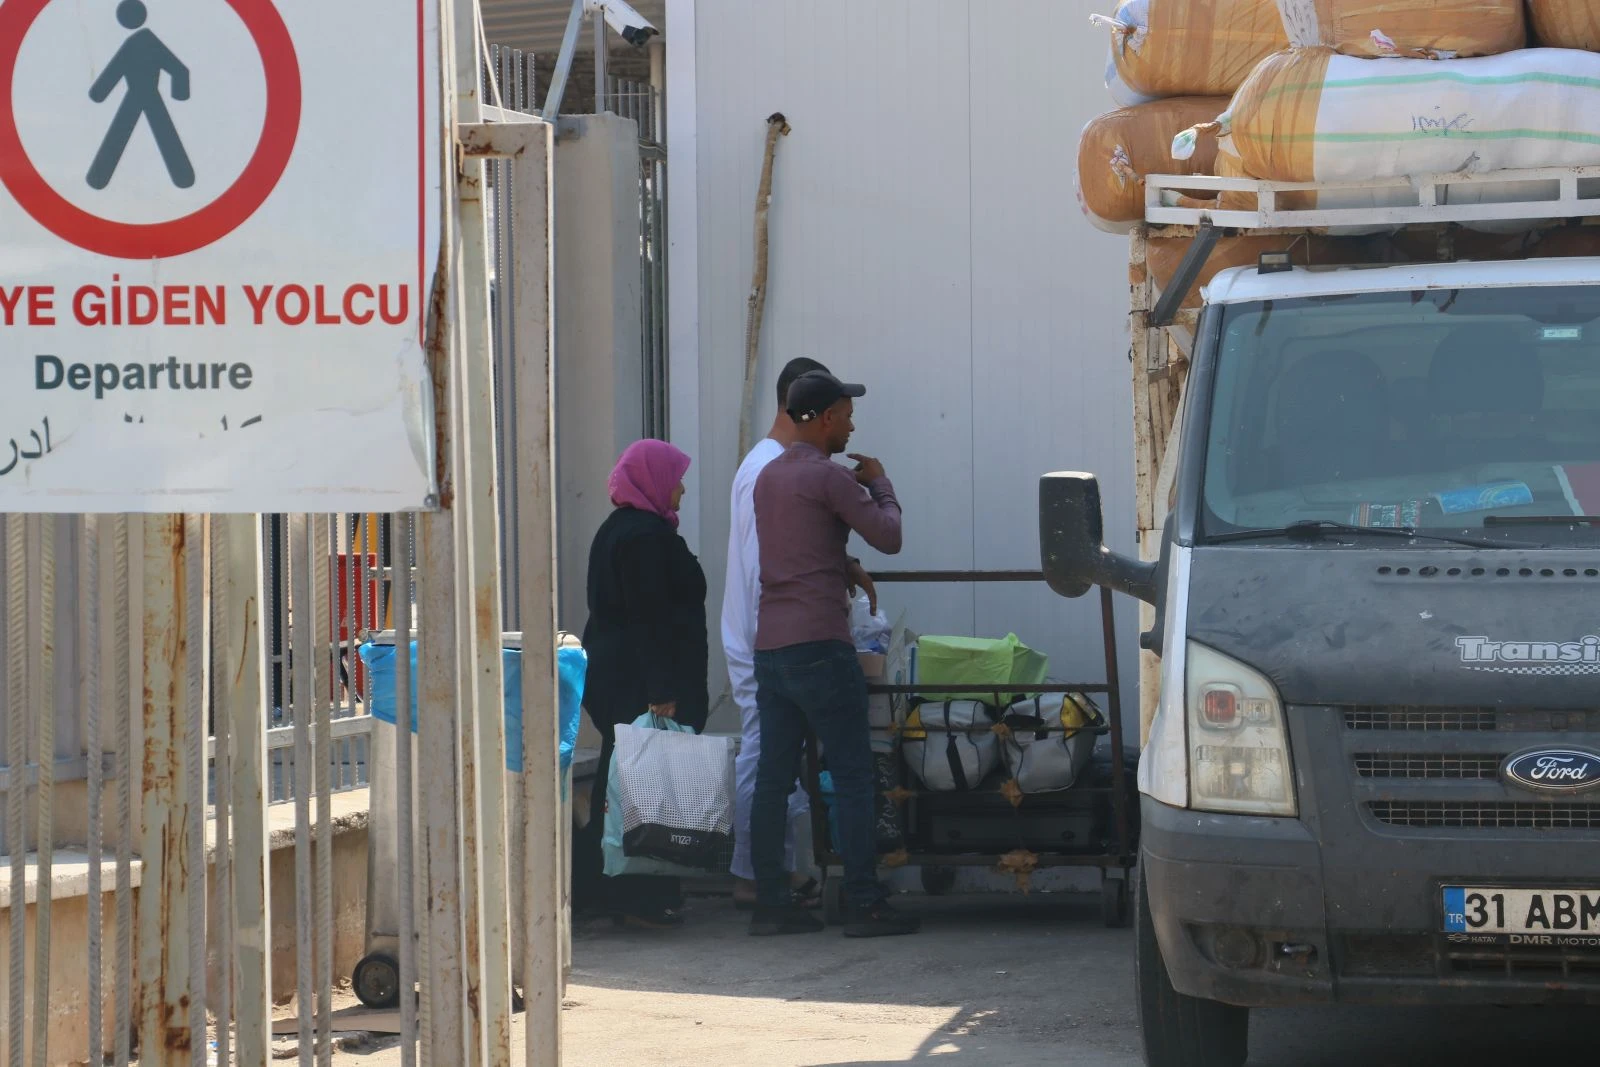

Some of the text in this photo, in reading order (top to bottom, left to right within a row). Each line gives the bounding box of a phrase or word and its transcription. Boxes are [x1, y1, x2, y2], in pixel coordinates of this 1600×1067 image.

[72, 273, 226, 326] GİDEN
[243, 284, 409, 325] YOLCU
[34, 354, 253, 399] Departure
[1455, 635, 1600, 662] Transi
[1530, 756, 1588, 780] Ford
[1448, 913, 1464, 924] TR
[1465, 893, 1600, 930] 31 ABM
[1509, 934, 1553, 945] DMR
[1557, 936, 1600, 946] MOTO
